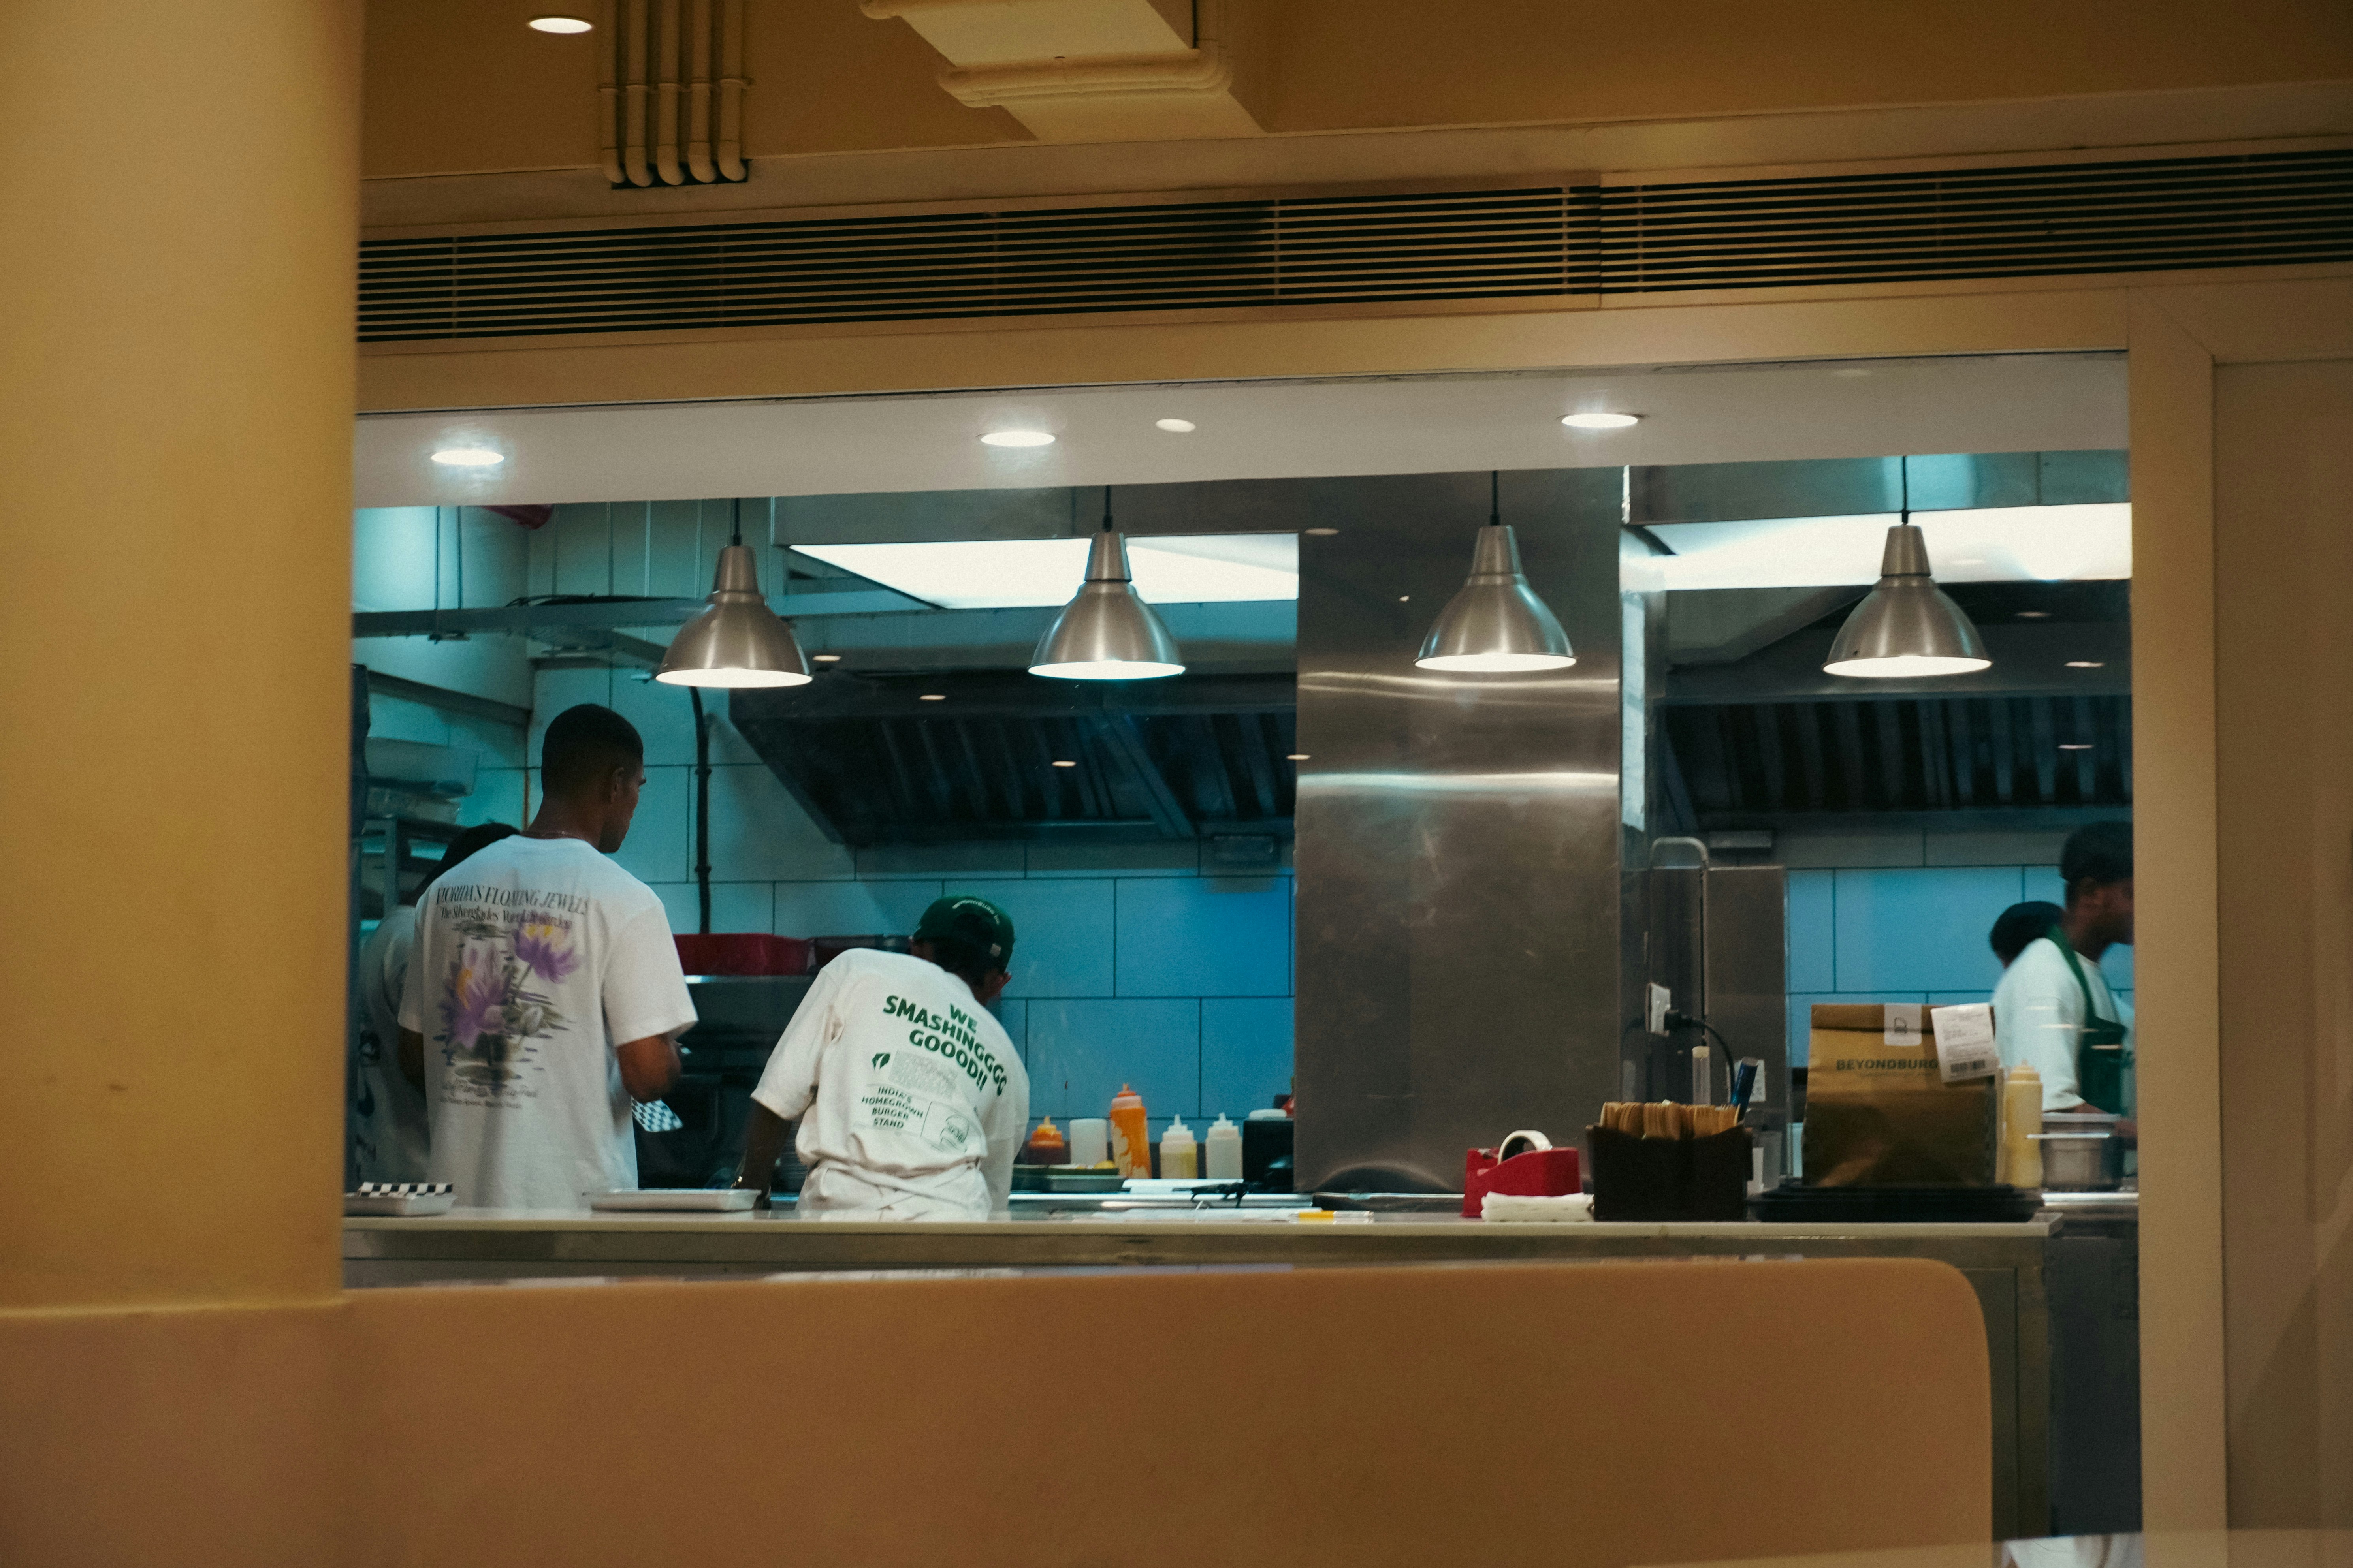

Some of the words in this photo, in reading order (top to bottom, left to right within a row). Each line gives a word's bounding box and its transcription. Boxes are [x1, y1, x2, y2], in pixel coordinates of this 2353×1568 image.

[950, 1002, 978, 1034] WE
[909, 1028, 988, 1093] GOOOD!!
[878, 1086, 913, 1103] INDIA'S
[861, 1096, 924, 1118] HOMEGROWN
[872, 1107, 909, 1120] BURGER
[872, 1117, 904, 1129] STAND
